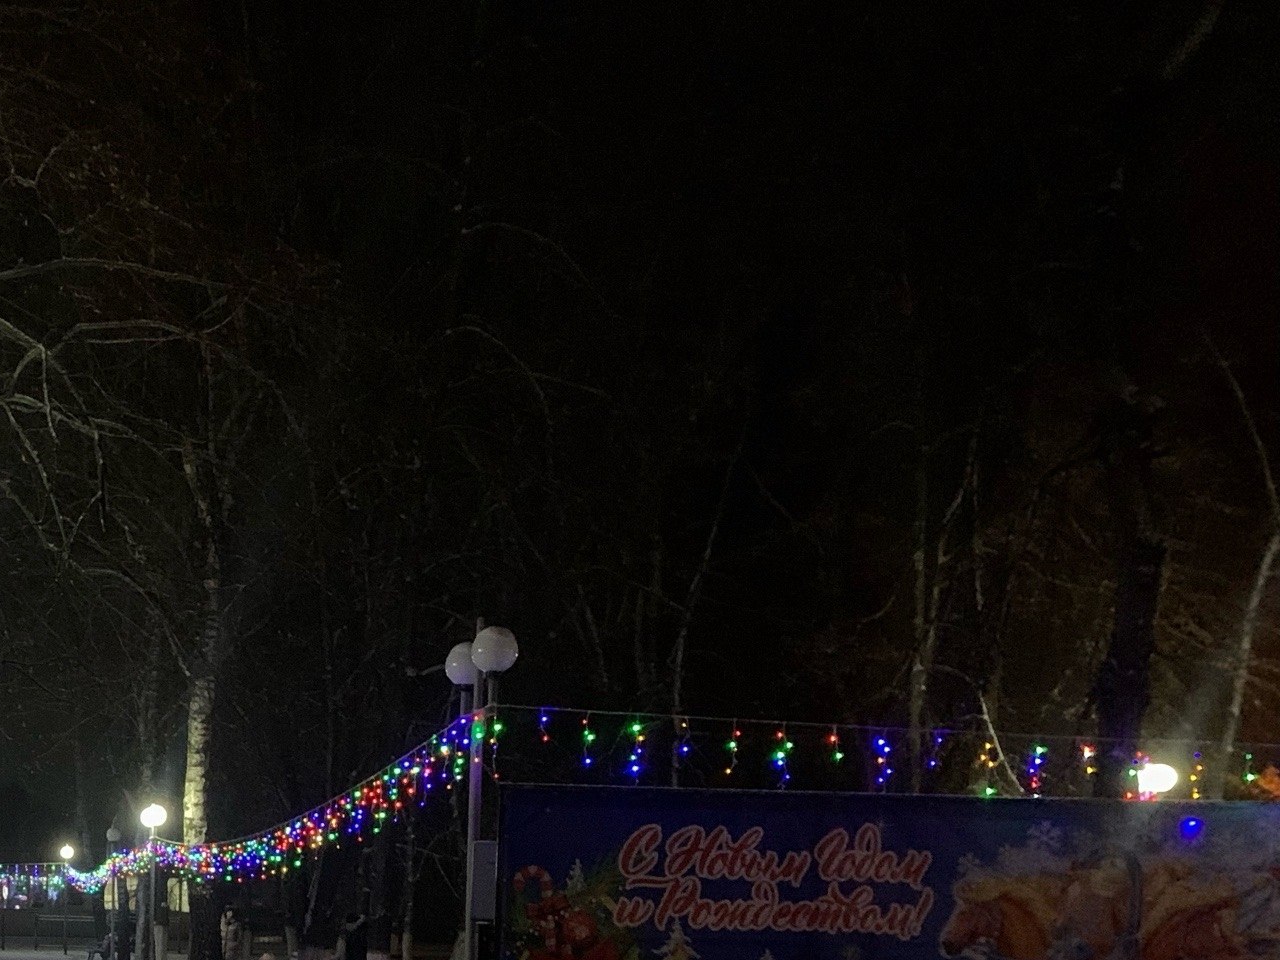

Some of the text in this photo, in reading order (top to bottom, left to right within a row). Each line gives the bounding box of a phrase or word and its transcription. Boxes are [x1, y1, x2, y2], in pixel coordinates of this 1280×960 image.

[619, 823, 932, 889] С Новым Годом
[613, 877, 934, 940] и Рождеством!
